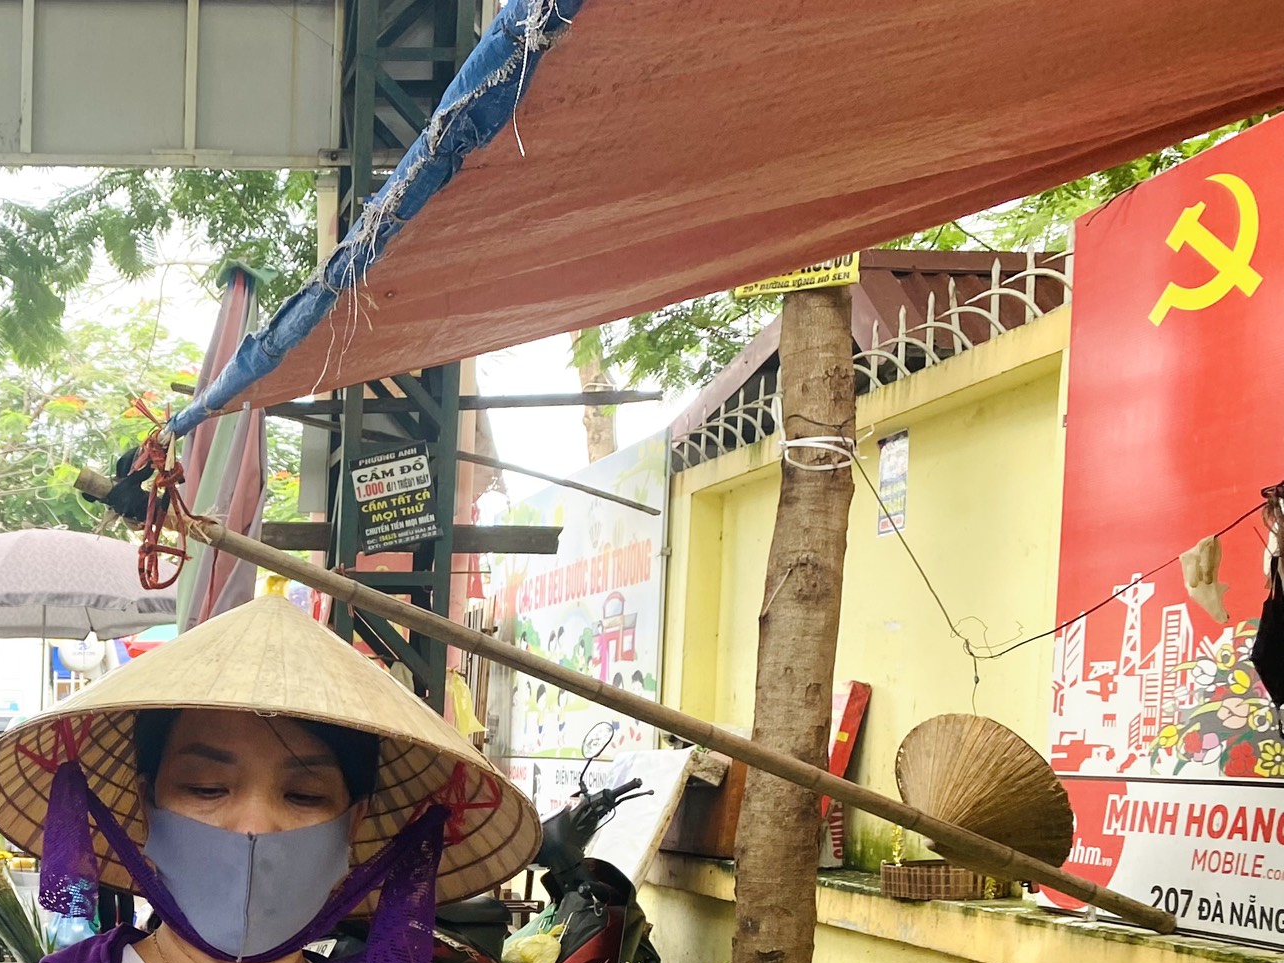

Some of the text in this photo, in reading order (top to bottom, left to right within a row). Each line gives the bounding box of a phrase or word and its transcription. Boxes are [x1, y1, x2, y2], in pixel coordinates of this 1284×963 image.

[831, 271, 851, 281] SEN
[398, 447, 417, 458] ANH
[356, 480, 385, 499] 1.000
[372, 510, 398, 523] MỌI
[1104, 797, 1180, 836] MINH
[1150, 885, 1193, 918] 207
[1198, 892, 1224, 924] ĐÀ
